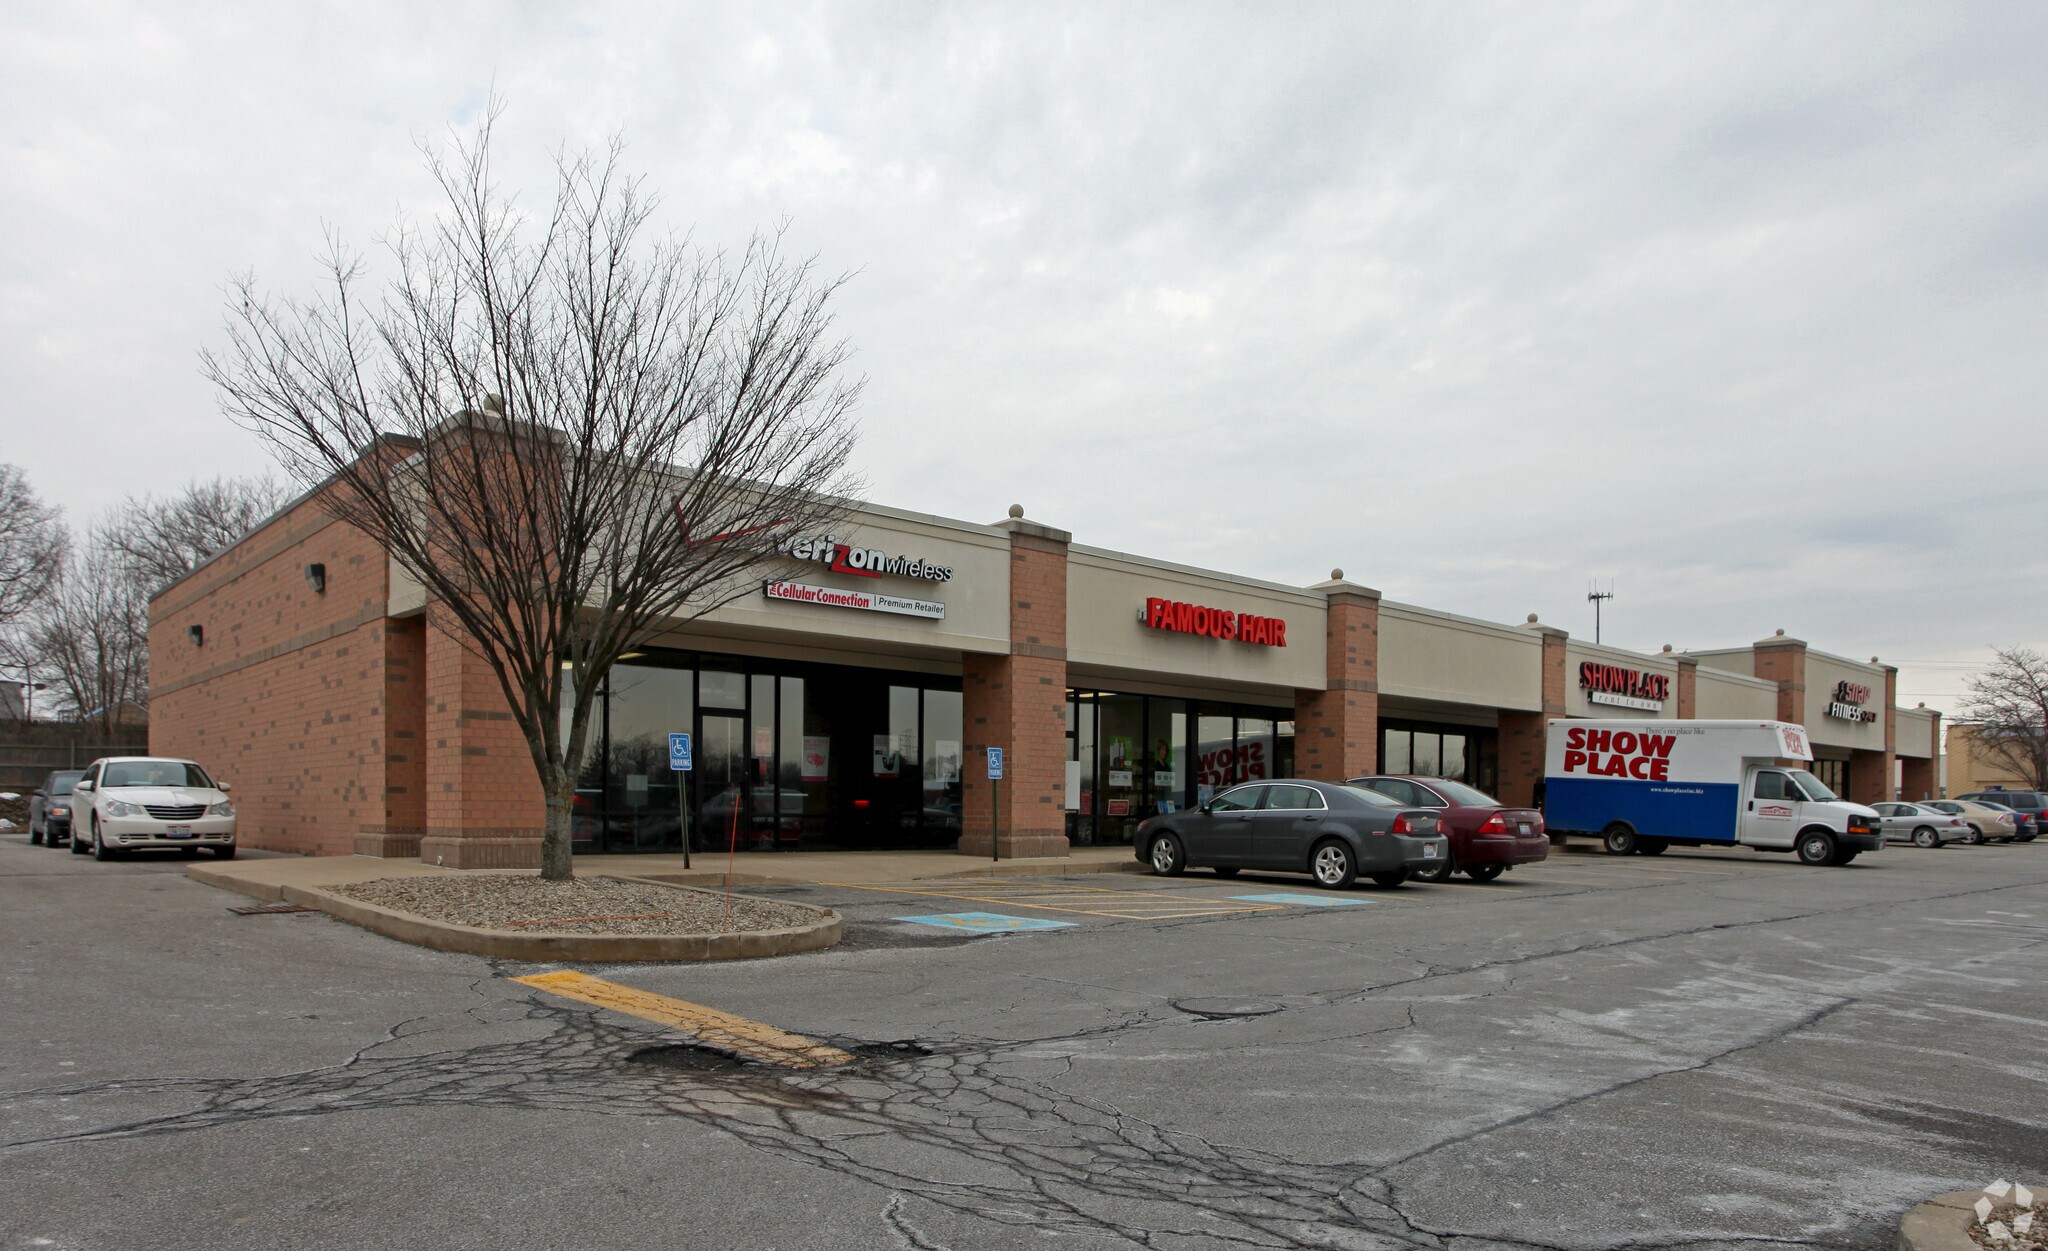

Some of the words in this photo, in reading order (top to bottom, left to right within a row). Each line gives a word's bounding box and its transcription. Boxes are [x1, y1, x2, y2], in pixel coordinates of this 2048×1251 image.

[777, 583, 818, 601] Cellular
[817, 588, 869, 608] Connection
[878, 597, 913, 610] Premium
[914, 602, 944, 614] Retailer
[1146, 597, 1236, 640] FAMOUS
[1238, 613, 1287, 647] HAIR
[1598, 694, 1620, 703] rent
[1626, 696, 1635, 706] to
[1640, 700, 1657, 709] own
[1566, 727, 1676, 758] SHOW
[1645, 727, 1667, 735] There's
[1676, 728, 1692, 736] place
[1693, 727, 1706, 735] like
[672, 758, 690, 767] PARKING
[1564, 750, 1670, 782] PLACE
